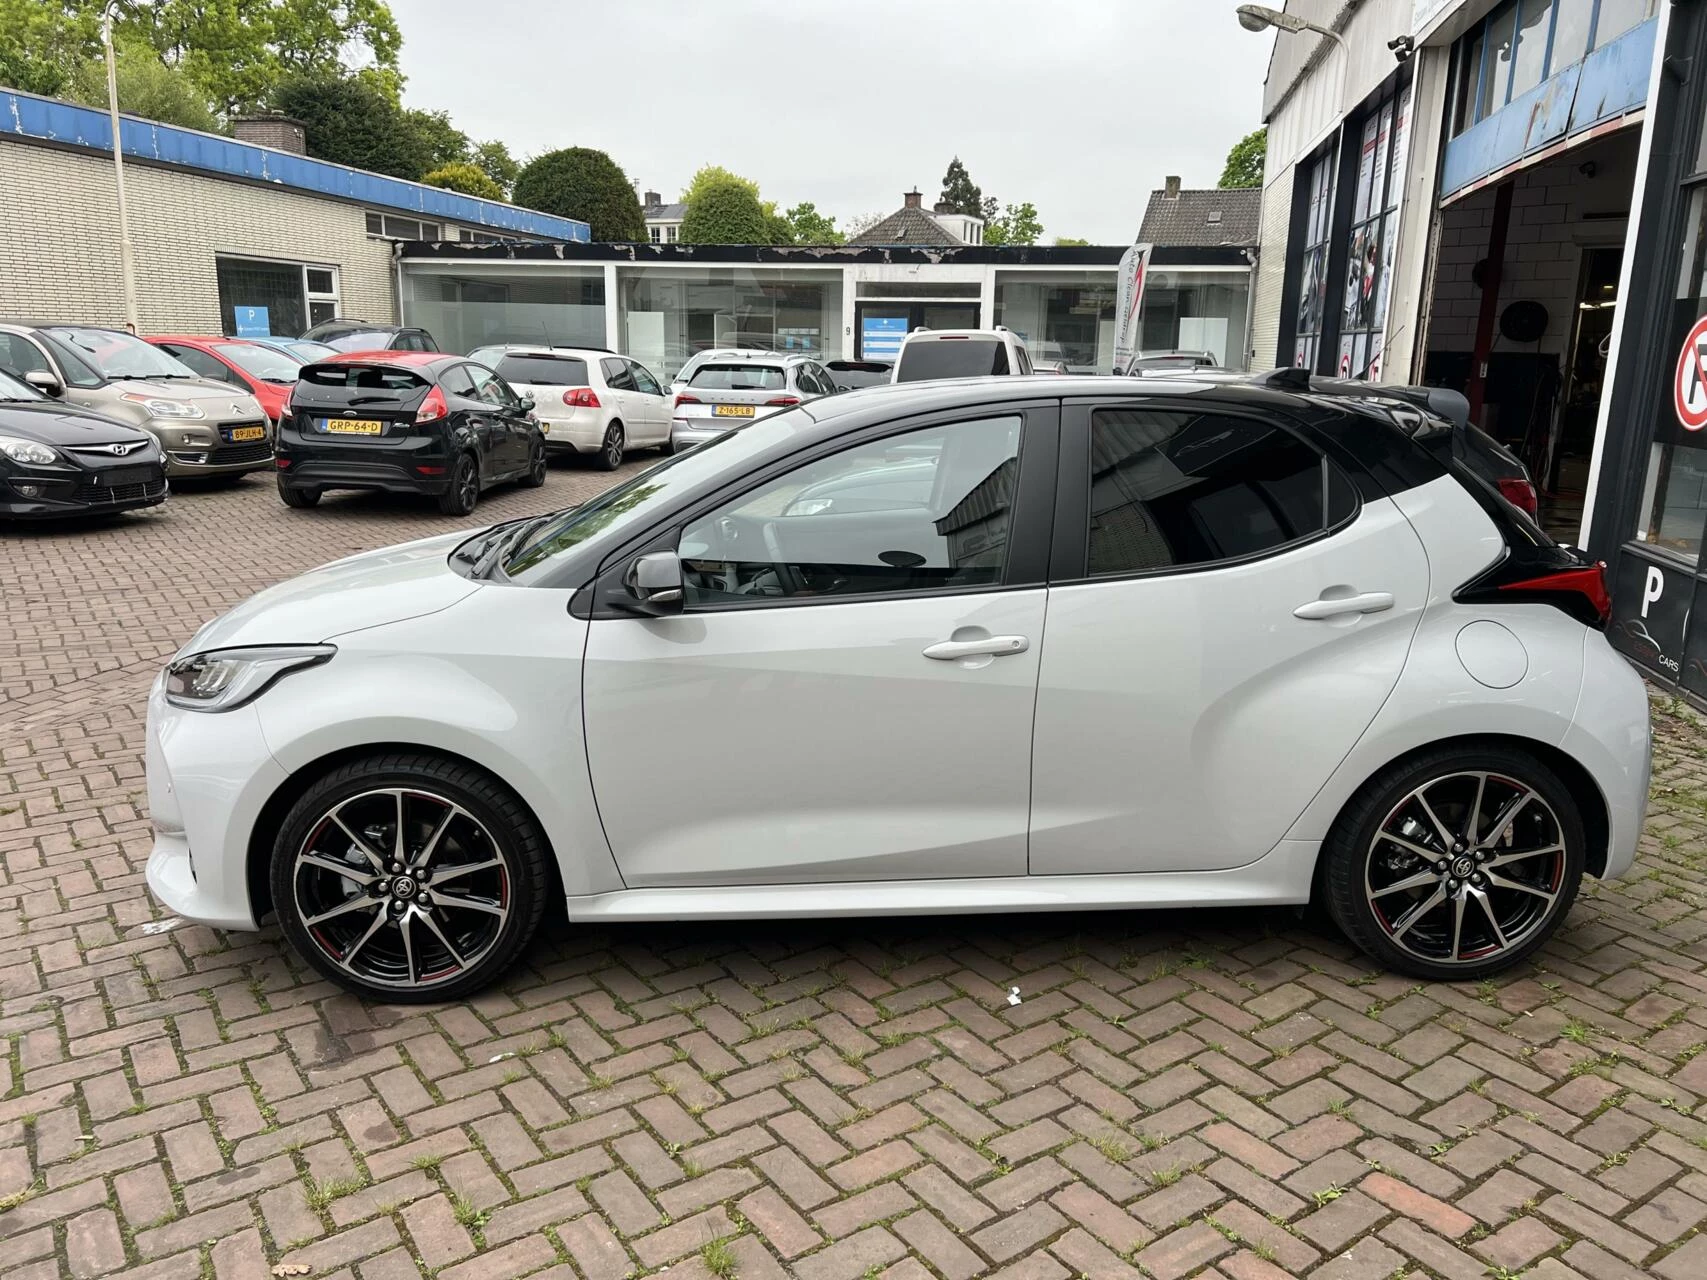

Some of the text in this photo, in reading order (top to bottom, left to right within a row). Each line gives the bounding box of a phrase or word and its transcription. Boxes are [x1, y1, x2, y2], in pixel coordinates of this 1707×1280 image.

[1128, 250, 1138, 273] Auto
[1125, 276, 1135, 303] Clean
[248, 309, 255, 321] P
[845, 326, 851, 336] 9
[330, 421, 378, 432] GRP-64-D
[1641, 565, 1664, 619] P
[1658, 654, 1679, 672] CARS
